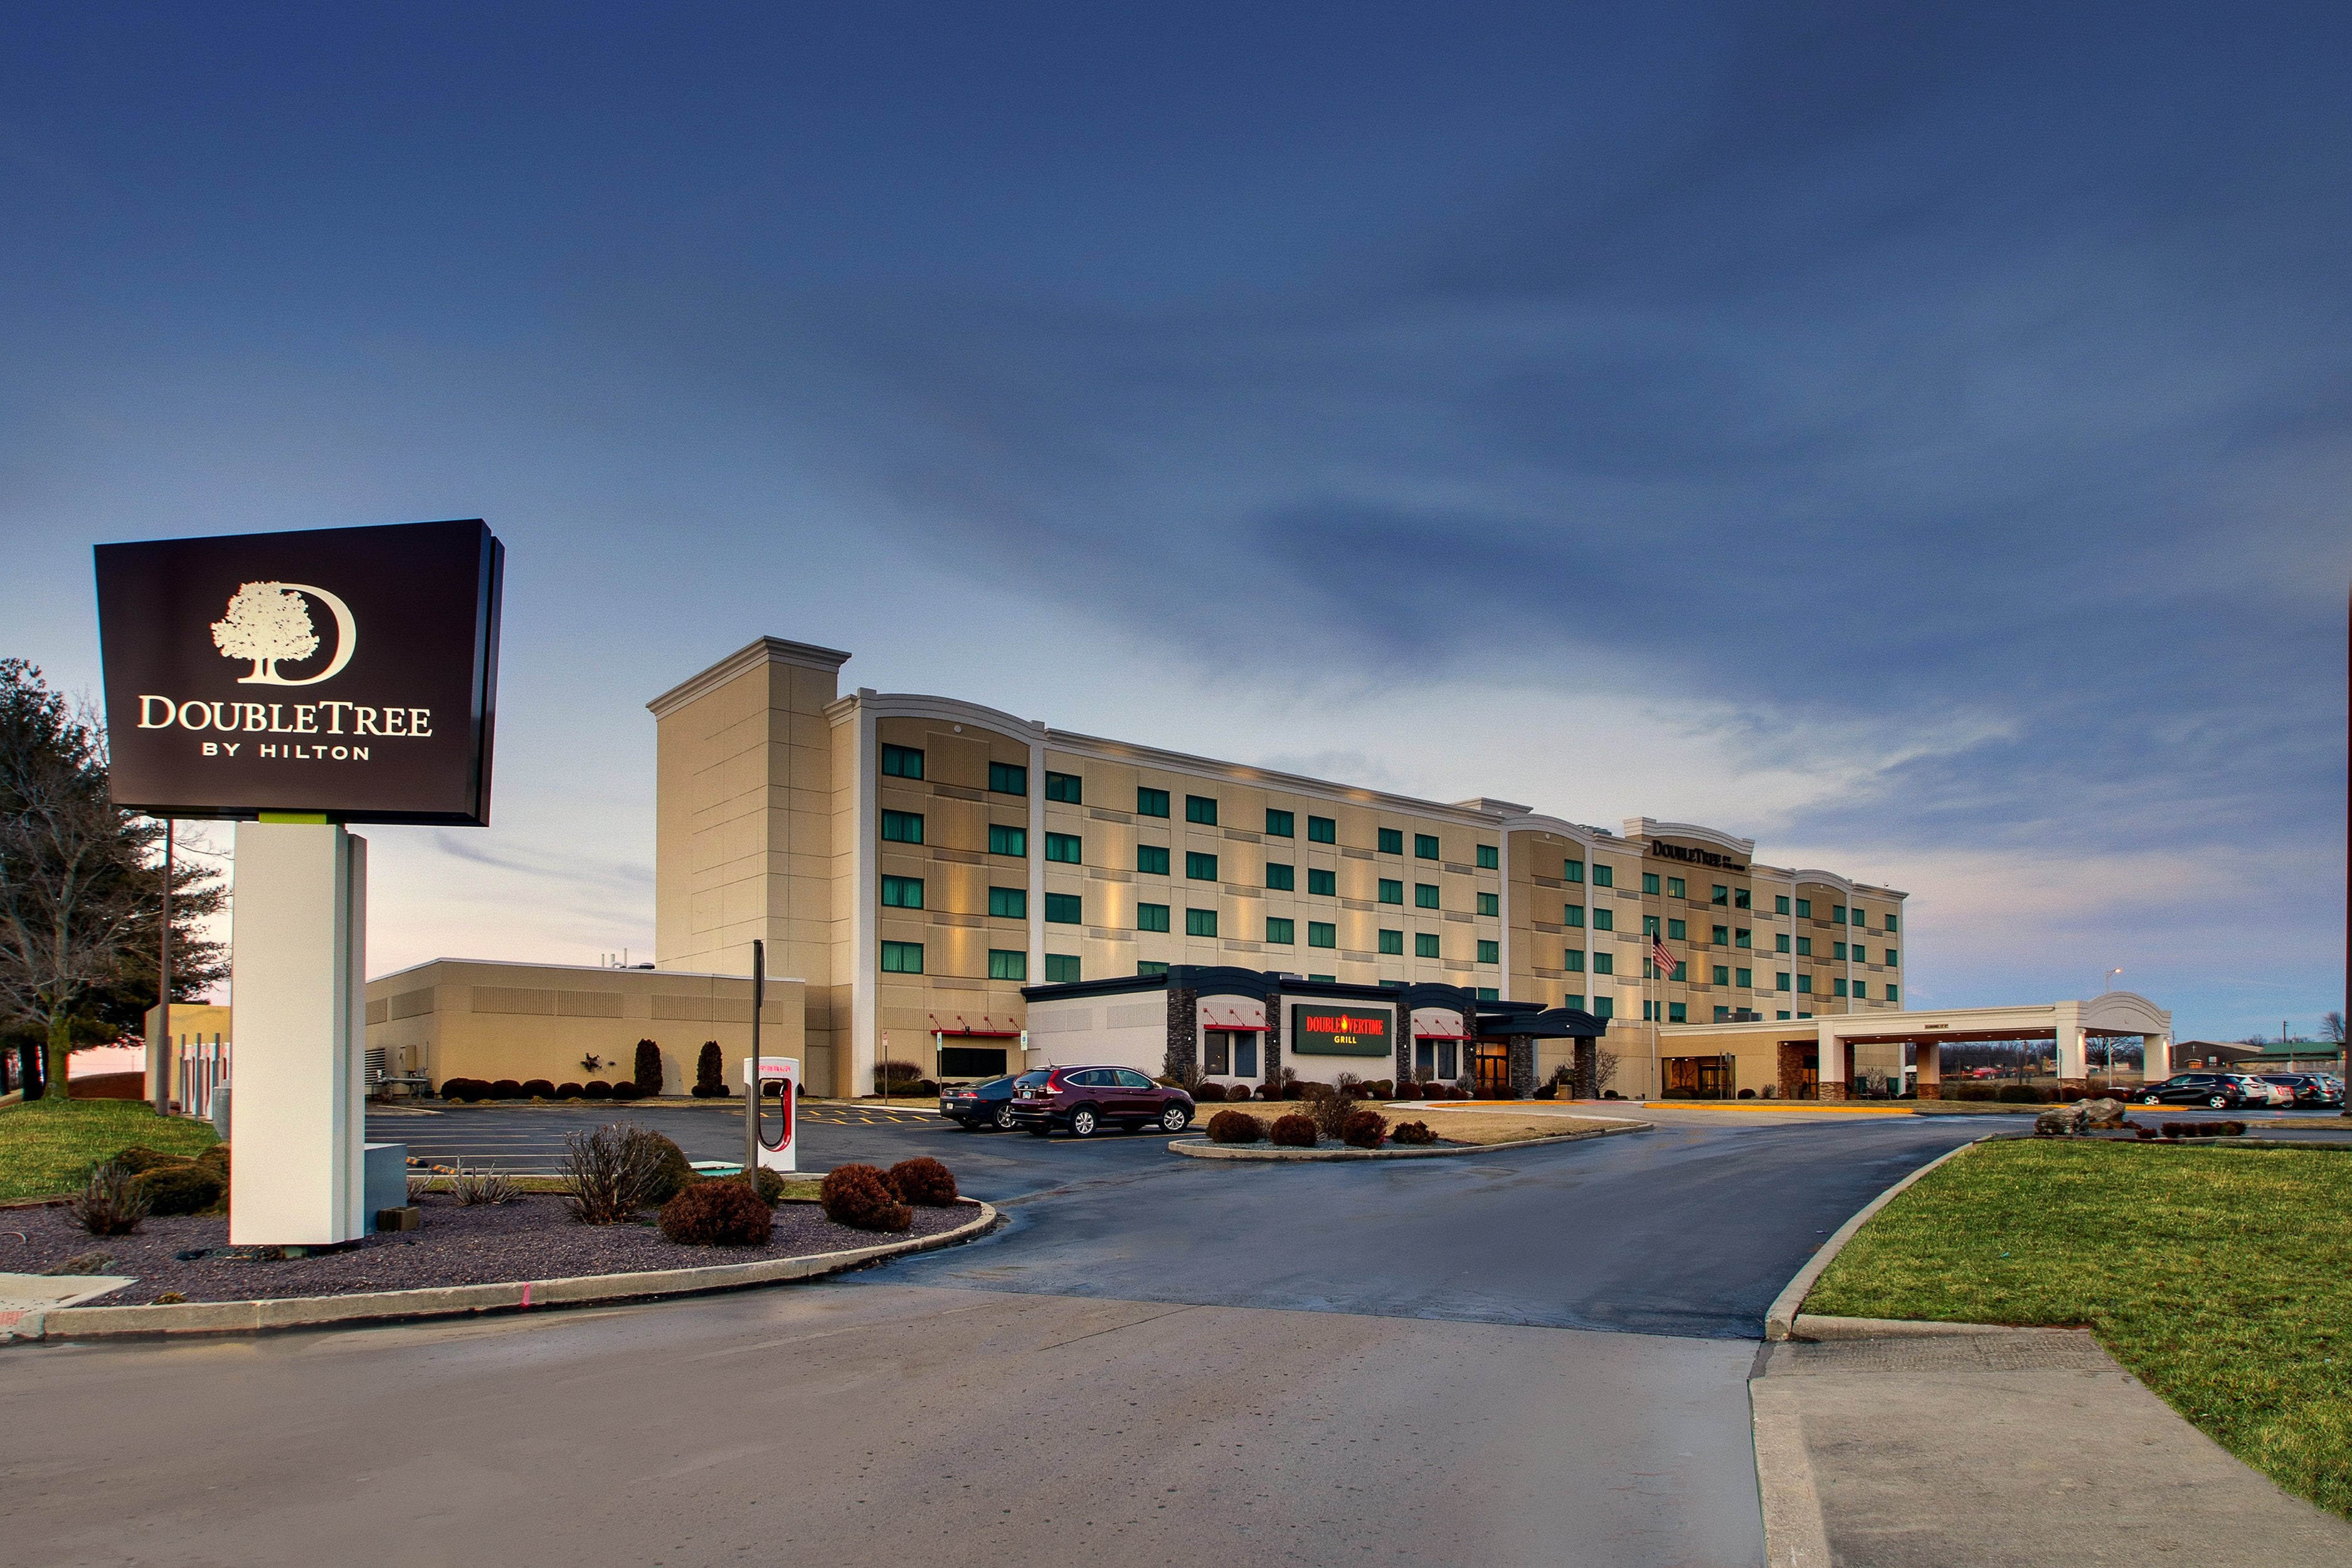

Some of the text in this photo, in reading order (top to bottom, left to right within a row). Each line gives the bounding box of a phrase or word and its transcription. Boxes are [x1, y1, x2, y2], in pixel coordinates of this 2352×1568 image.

[137, 694, 433, 737] DOUBLETREE
[201, 742, 369, 760] BY HILTON
[1334, 1036, 1357, 1044] GRILL
